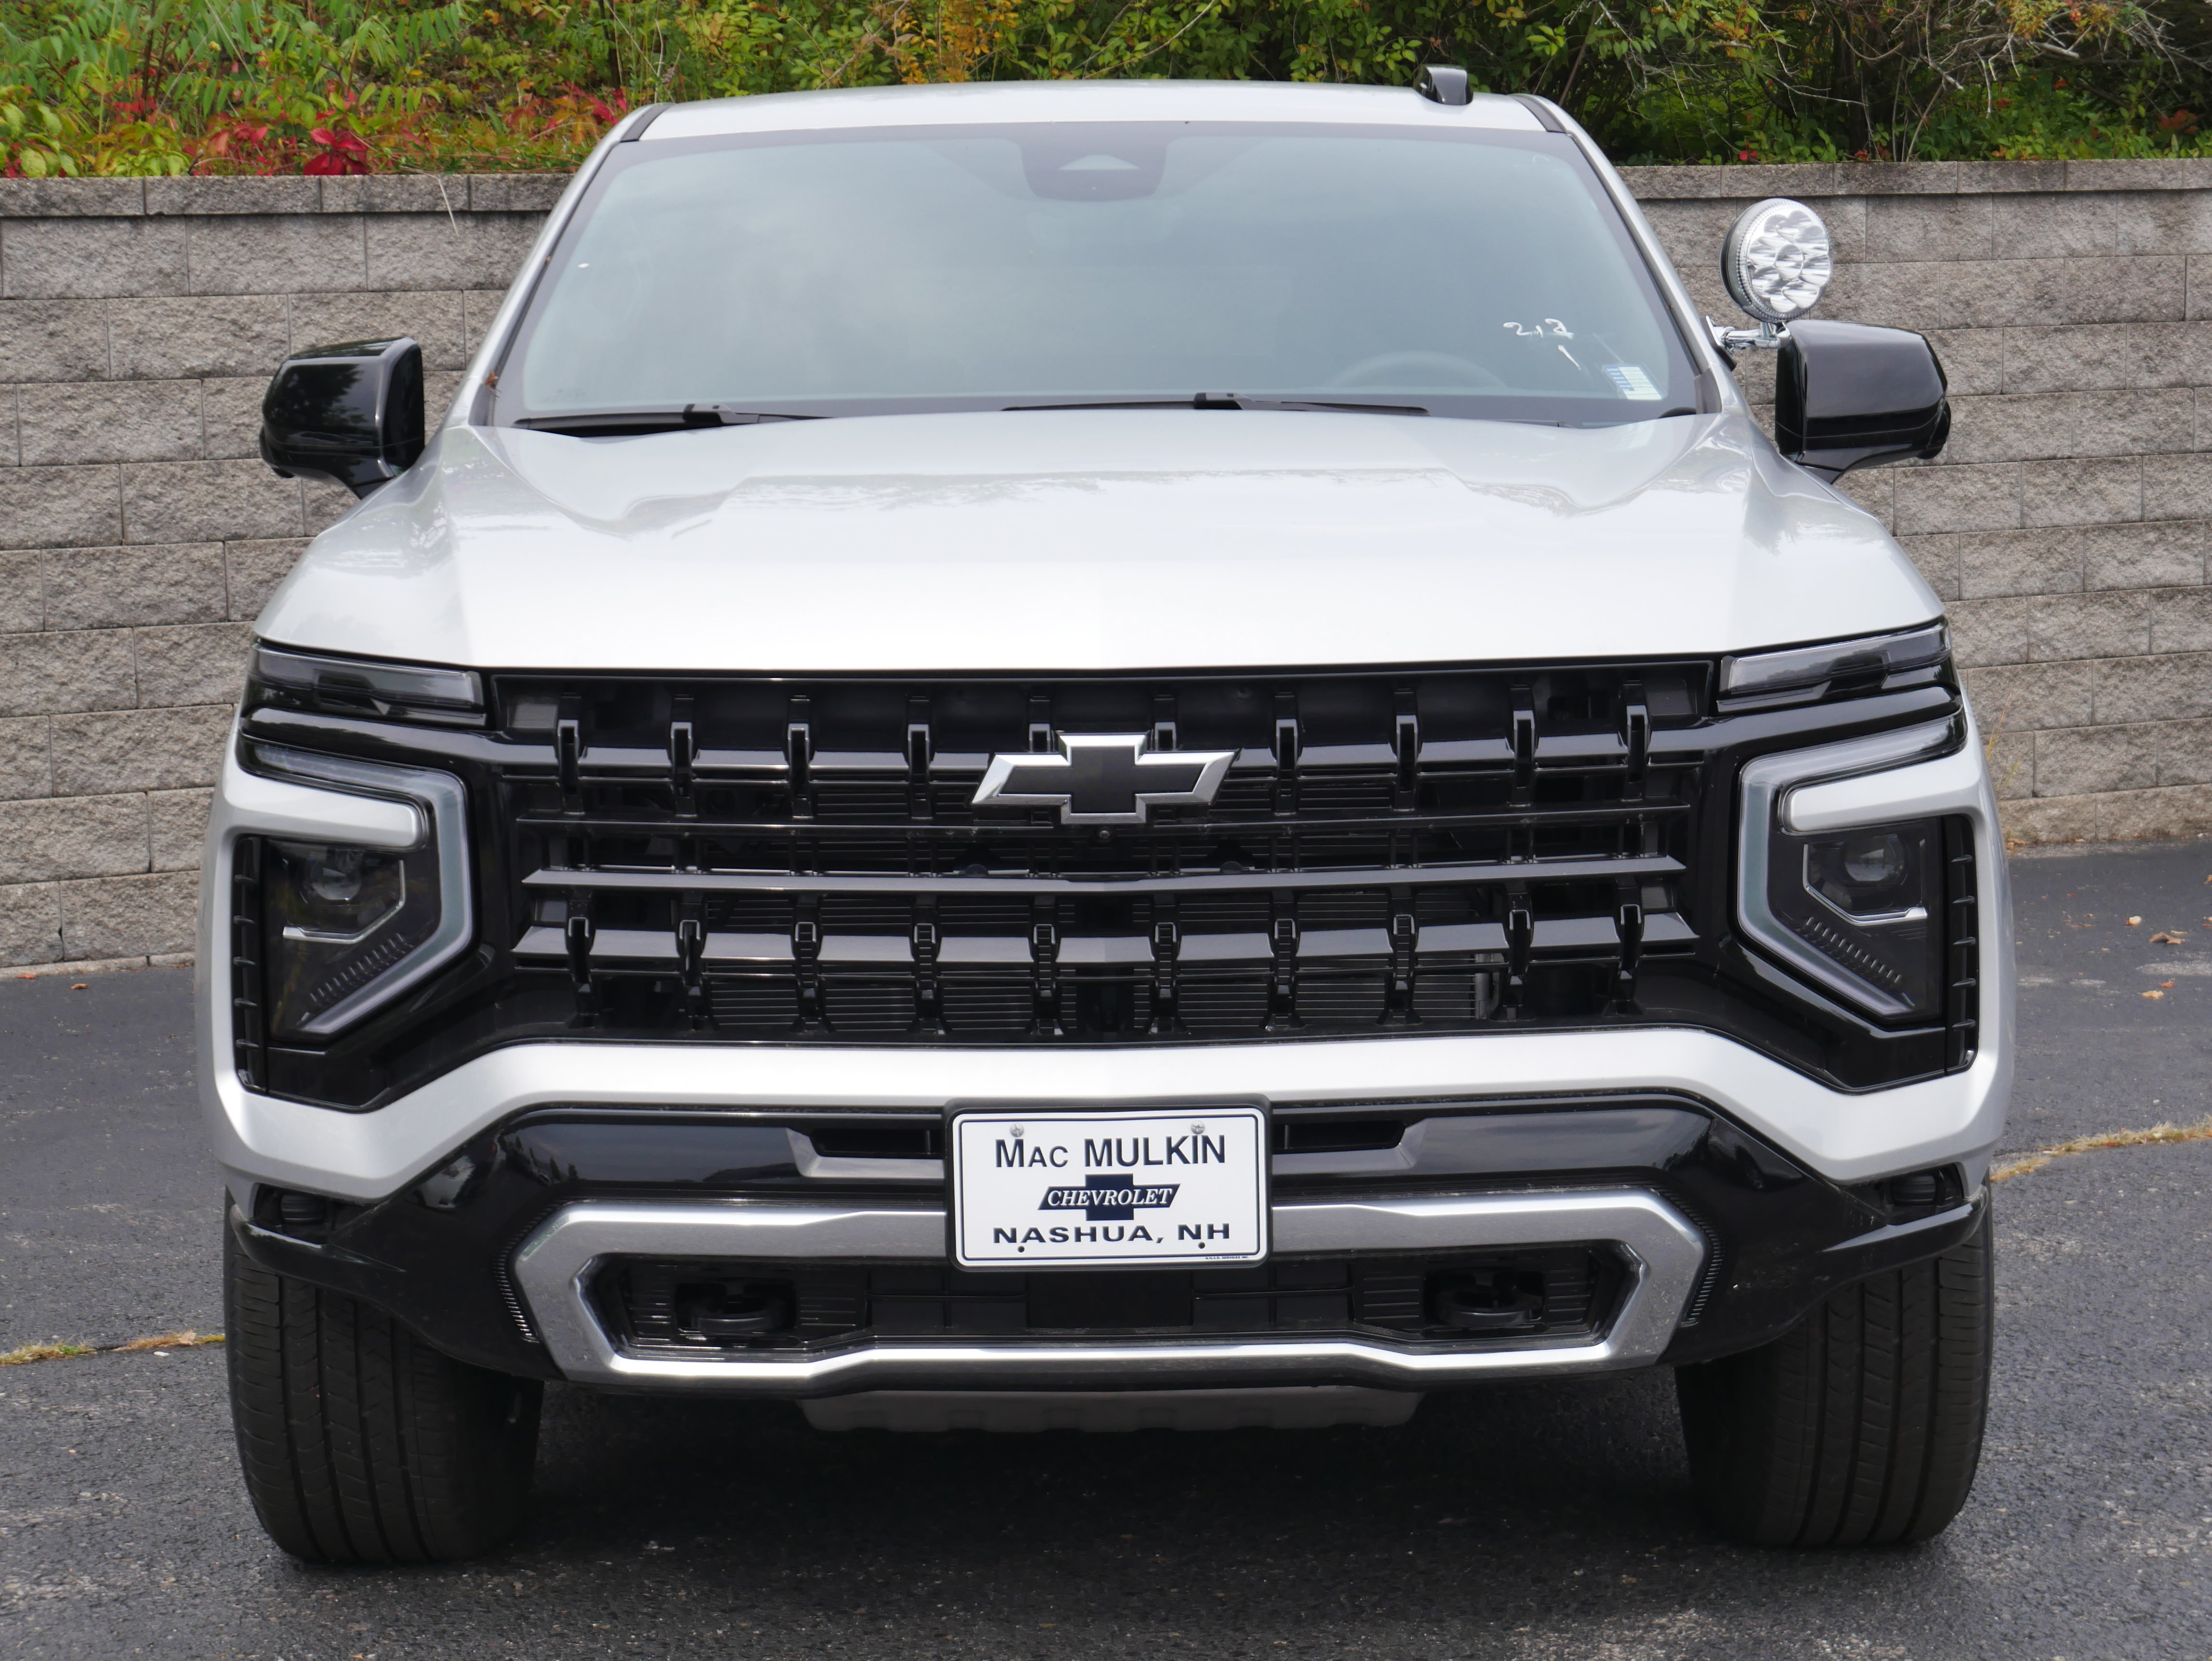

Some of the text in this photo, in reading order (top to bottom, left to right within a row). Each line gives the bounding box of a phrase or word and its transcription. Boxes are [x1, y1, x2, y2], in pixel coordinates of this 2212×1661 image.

[1084, 1135, 1225, 1167] MULKIN
[1047, 1188, 1173, 1206] CHEVROLET
[993, 1223, 1230, 1243] NASHUA, NH
